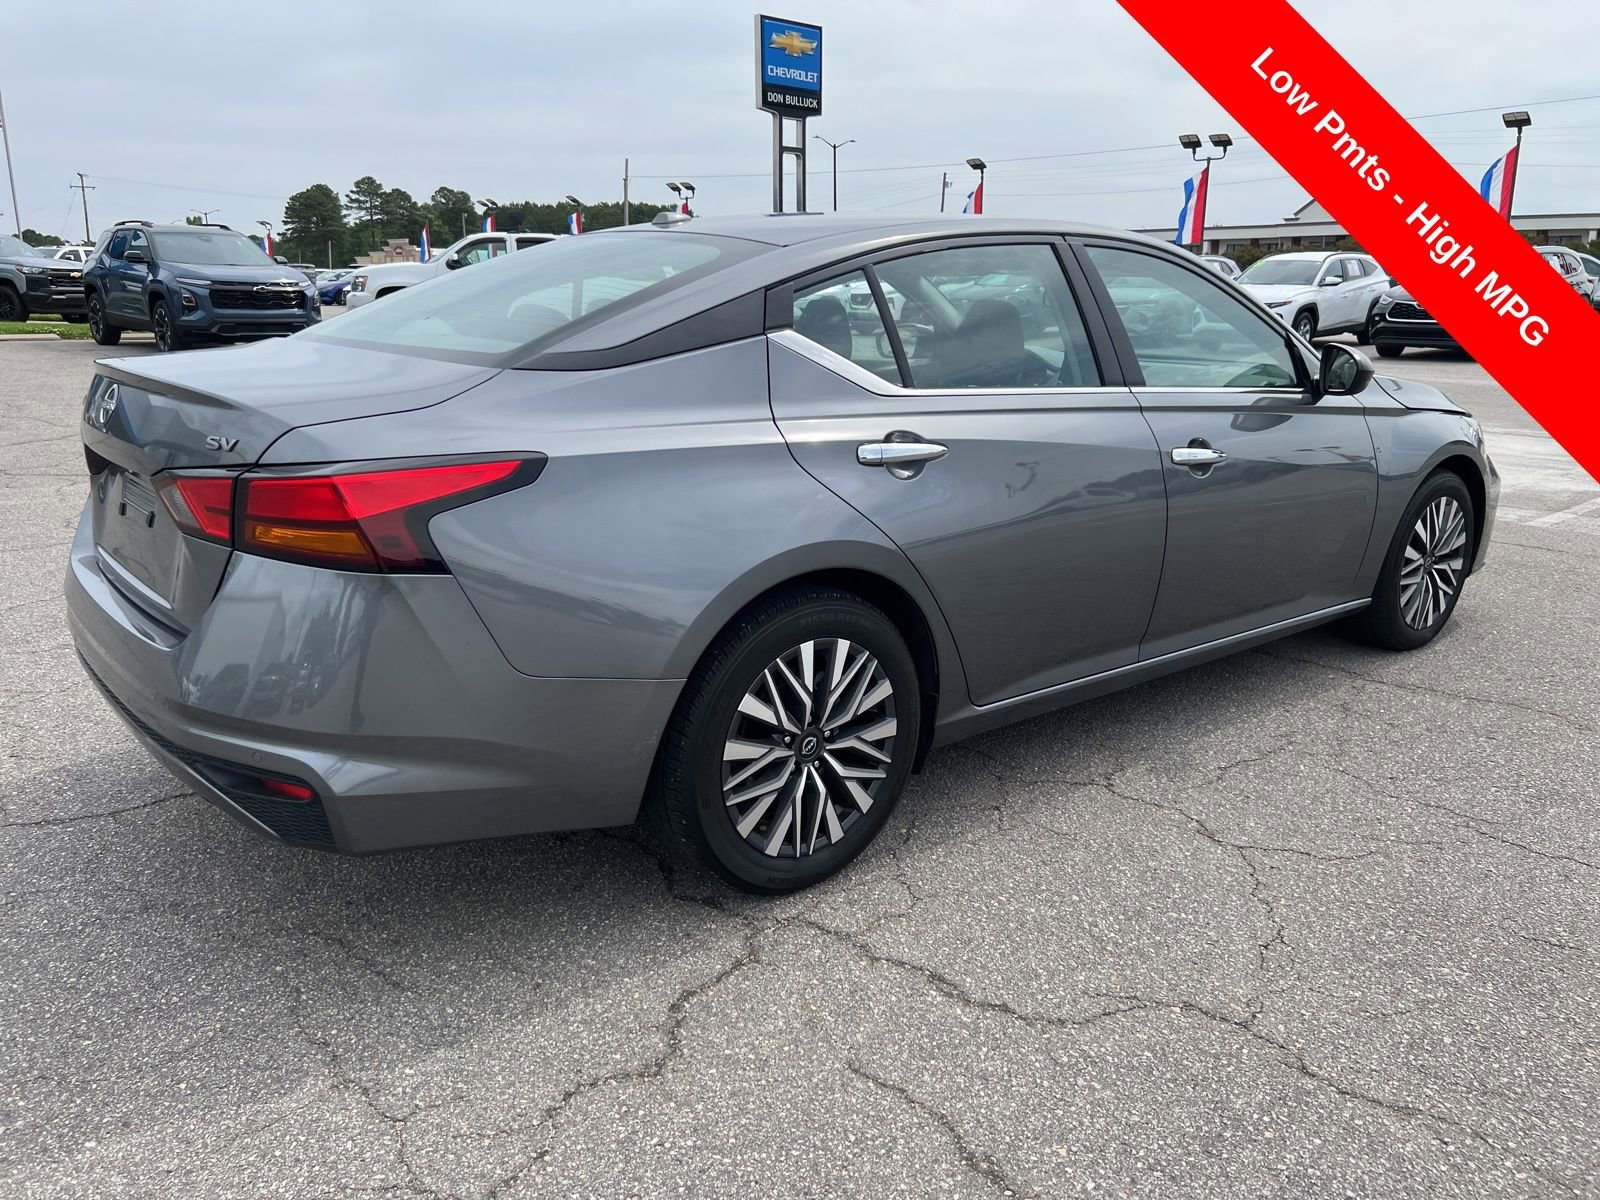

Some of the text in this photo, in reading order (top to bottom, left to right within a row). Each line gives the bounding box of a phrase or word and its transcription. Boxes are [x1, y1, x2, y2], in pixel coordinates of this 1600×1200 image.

[767, 65, 818, 83] CHEVROLET
[767, 92, 818, 108] DON BULLUCK
[205, 436, 240, 452] SV
